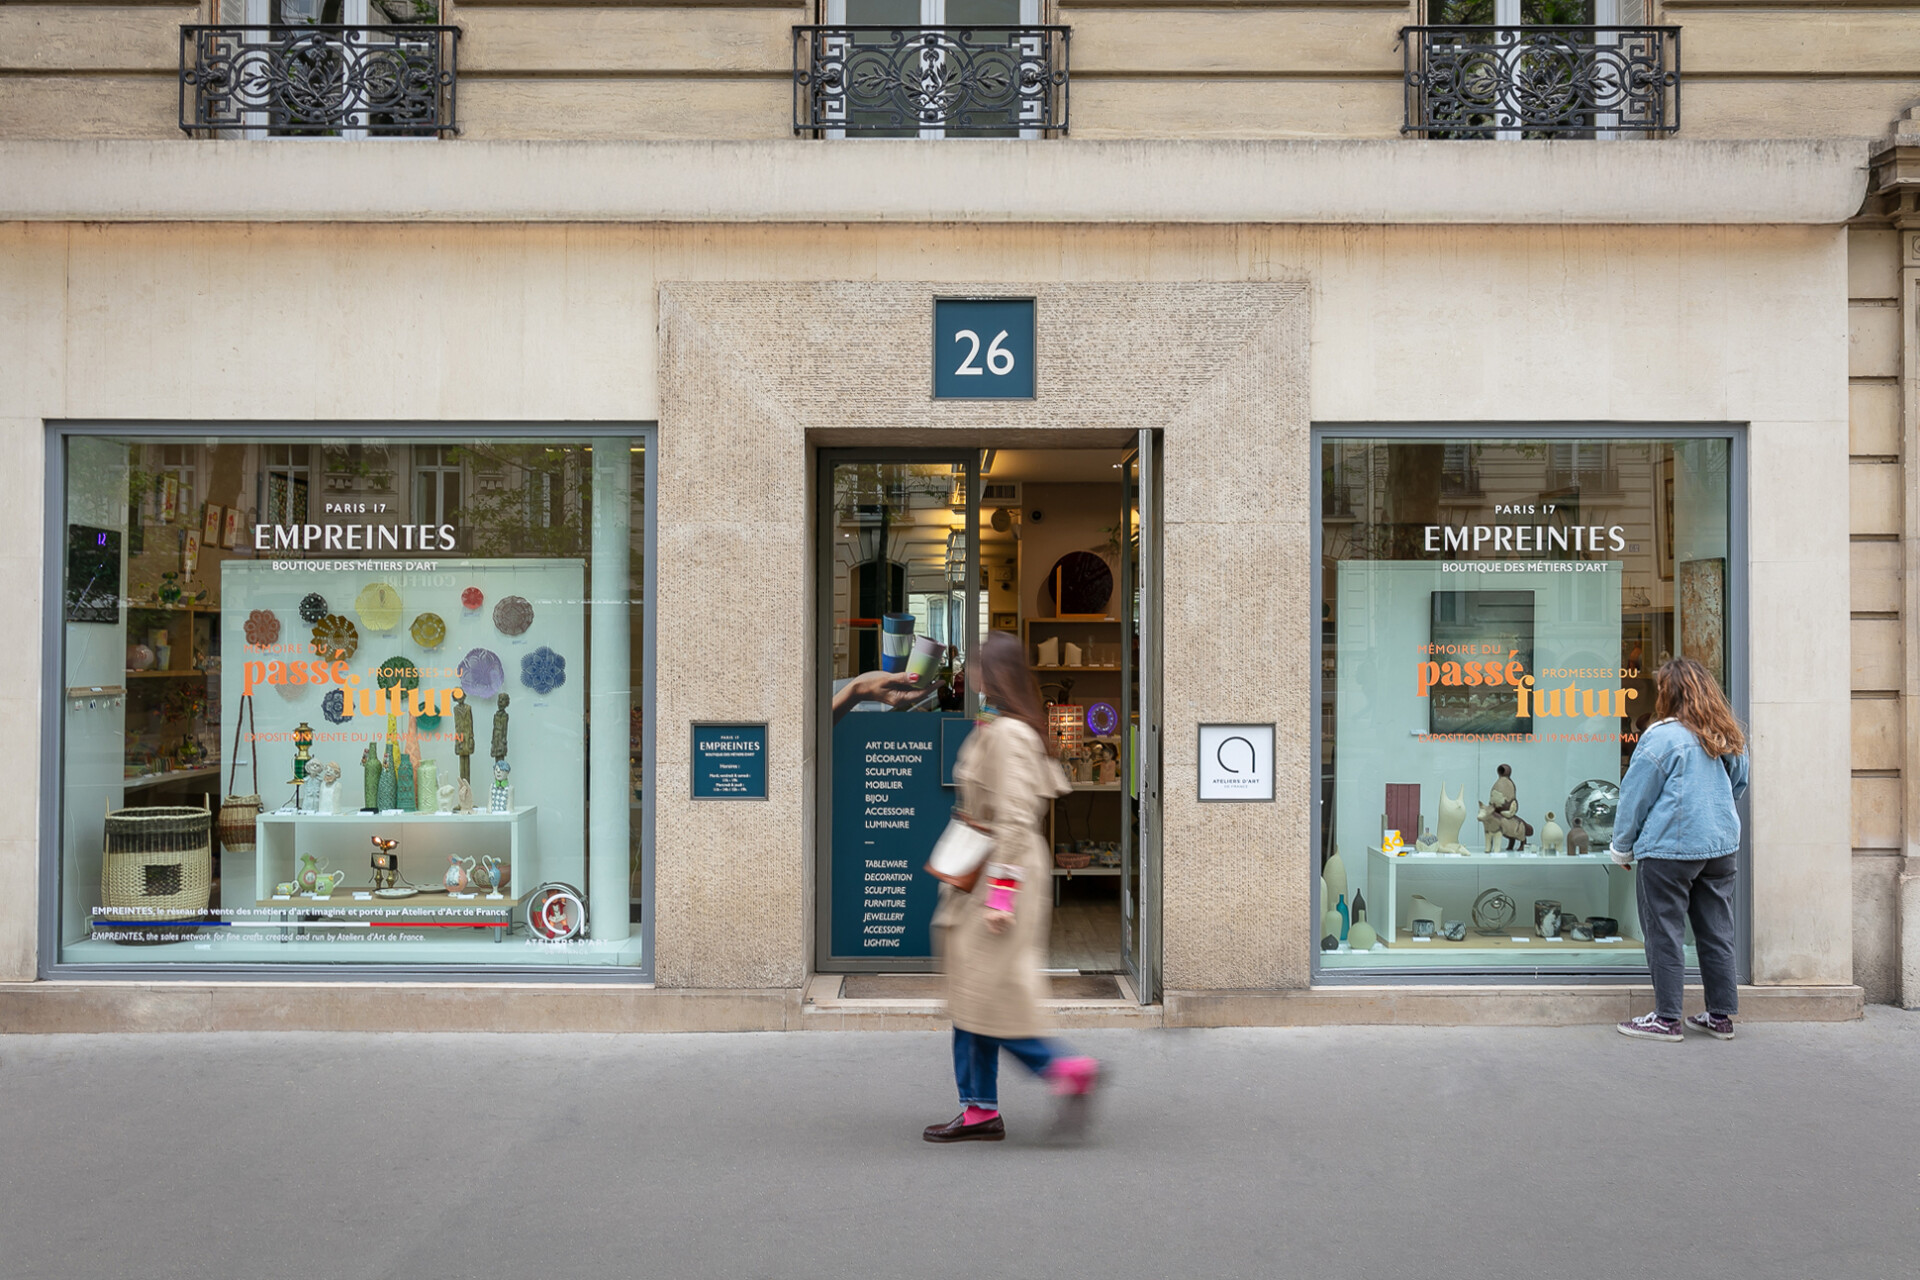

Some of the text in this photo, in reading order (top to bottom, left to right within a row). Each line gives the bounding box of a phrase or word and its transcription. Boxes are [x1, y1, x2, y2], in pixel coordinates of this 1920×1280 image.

[954, 329, 1015, 376] 26
[326, 503, 387, 513] PARIS 17
[1495, 505, 1556, 515] PARIS 17
[255, 523, 456, 551] EMPREINTES
[1424, 525, 1626, 552] EMPREINTES
[272, 558, 438, 573] BOUTIQUE DES MÉTIERS D'ART
[1442, 560, 1608, 574] BOUTIQUE DES MÉTIERS D'ART
[243, 642, 328, 654] MÉMOIRE DU
[1417, 642, 1501, 655] MÉMOIRE DU
[242, 649, 350, 697] passé
[368, 667, 464, 678] PROMESSES DU
[1416, 649, 1524, 697] passé
[1542, 668, 1638, 679] PROMESSES DU
[341, 673, 464, 717] futur
[1513, 674, 1638, 718] futur
[351, 732, 368, 743] DU
[371, 732, 383, 743] 19
[414, 732, 432, 743] AU
[435, 732, 441, 743] 9
[444, 732, 464, 743] MAI
[1525, 733, 1543, 743] DU
[1546, 733, 1557, 743] 19
[1560, 733, 1588, 743] MARS
[1588, 733, 1606, 743] AU
[1609, 733, 1616, 743] 9
[1618, 733, 1639, 743] MAI
[700, 741, 760, 751] EMPREINTES
[865, 741, 933, 750] ART DE LA TABLE
[865, 753, 922, 763] DÉCORATION
[865, 767, 912, 776] SCULPTURE
[865, 780, 903, 789] MOBILIER
[865, 794, 889, 804] BIJOU
[864, 807, 915, 816] ACCESSOIRE
[865, 820, 910, 829] LUMINAIRE
[864, 859, 908, 868] TABLEWARE
[864, 873, 913, 881] DECORATION
[864, 886, 906, 895] SCULPTURE
[863, 899, 906, 908] FURNITURE
[91, 907, 156, 917] EMPREINTES,
[157, 907, 164, 916] le
[166, 907, 195, 916] réseau
[197, 907, 208, 916] de
[236, 907, 251, 916] des
[253, 907, 287, 916] métiers
[288, 907, 309, 916] d'art
[312, 907, 346, 917] imaginé
[348, 907, 357, 916] et
[359, 907, 383, 917] porté
[385, 909, 401, 917] par
[401, 907, 436, 916] Ateliers
[437, 907, 461, 916] d'Art
[462, 907, 474, 916] de
[476, 907, 509, 916] France.
[862, 912, 905, 923] JEWELLERY
[863, 925, 906, 934] ACCESSORY
[91, 932, 145, 942] EMPREINTES,
[146, 932, 158, 940] the
[160, 932, 179, 940] sales
[181, 932, 211, 940] network
[213, 932, 224, 942] for
[225, 932, 240, 942] fine
[242, 932, 263, 942] crafts
[265, 932, 294, 940] created
[296, 932, 310, 941] and
[327, 933, 336, 943] by
[337, 933, 365, 941] Ateliers
[366, 933, 386, 941] d'Art
[388, 933, 397, 941] de
[399, 933, 426, 941] France.
[863, 938, 900, 947] LIGHTING
